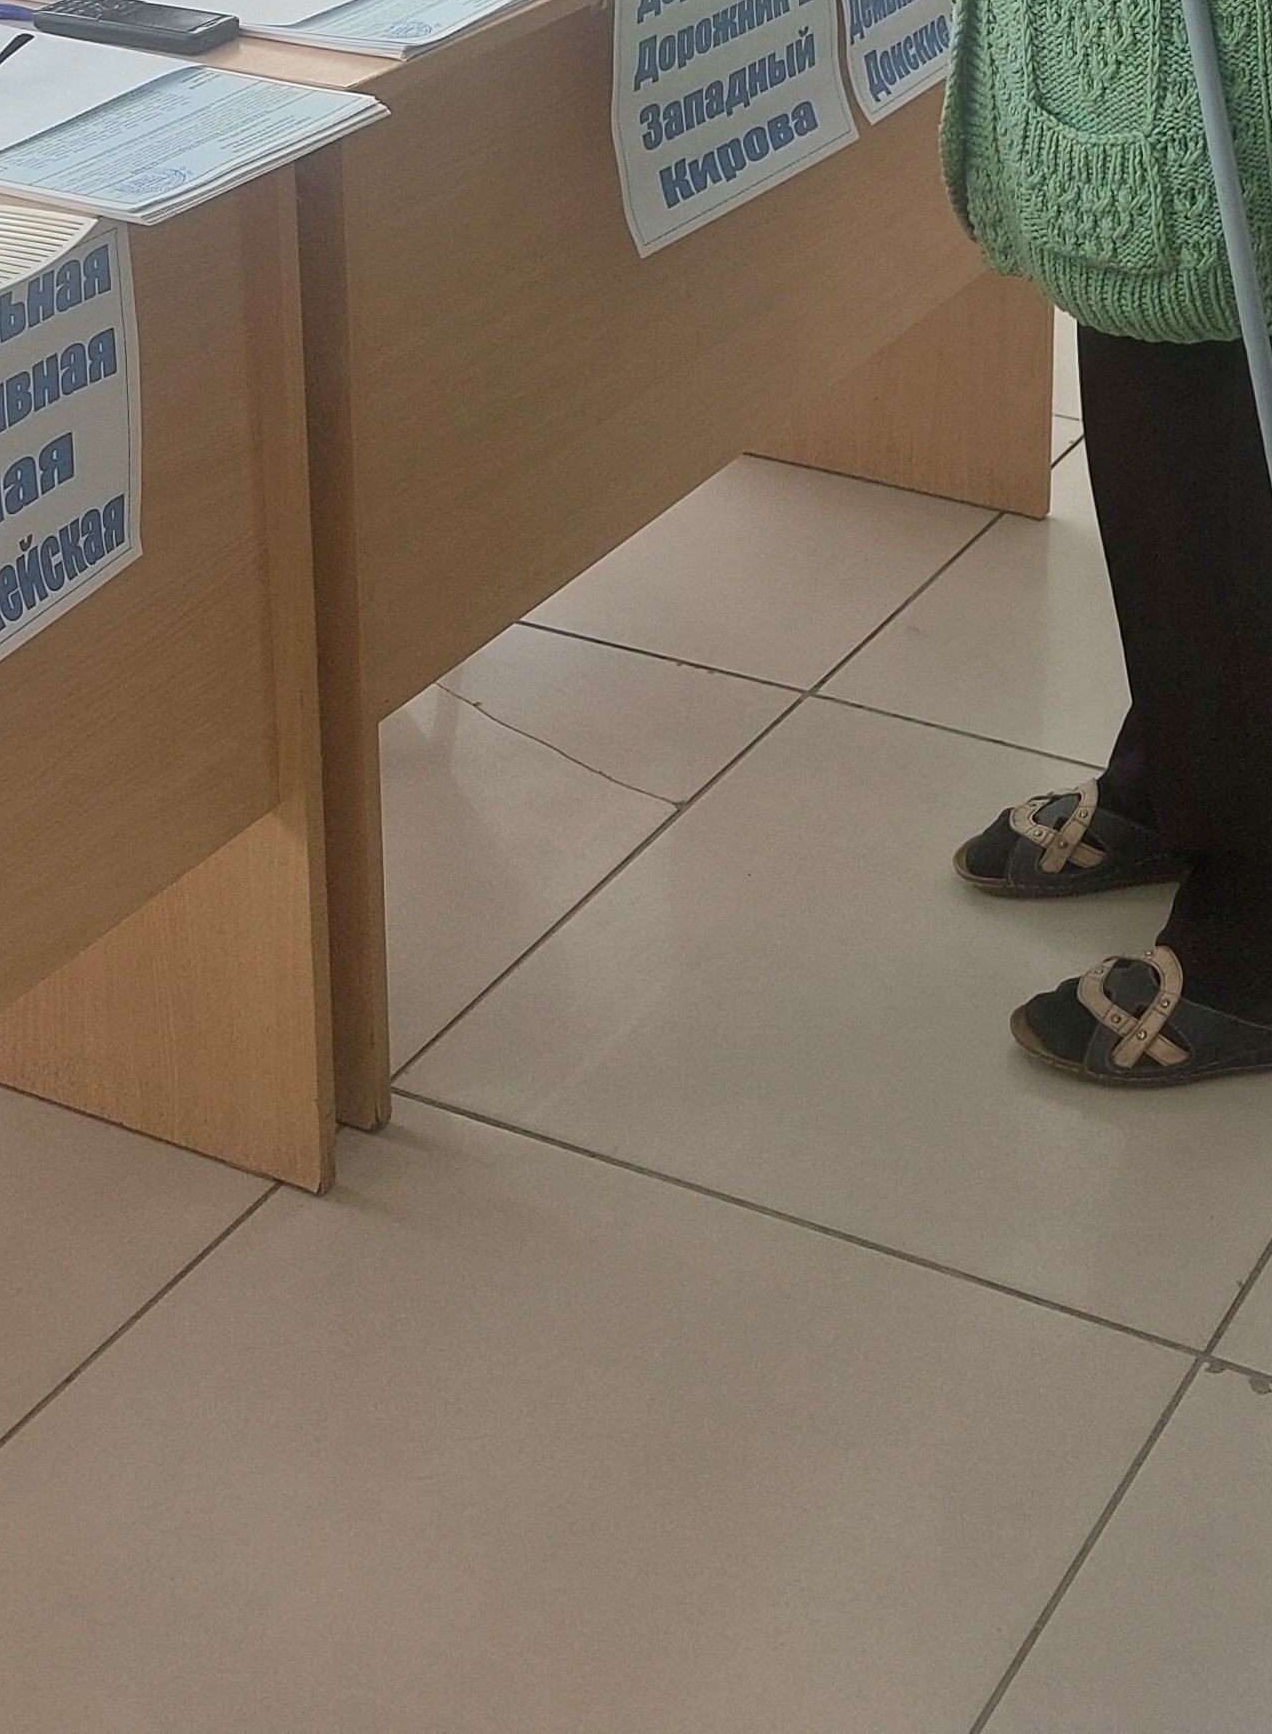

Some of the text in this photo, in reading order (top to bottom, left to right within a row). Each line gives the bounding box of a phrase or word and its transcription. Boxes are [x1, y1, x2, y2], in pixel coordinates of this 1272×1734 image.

[639, 25, 816, 150] Западный
[864, 15, 951, 102] Донские
[659, 100, 819, 209] Кирова
